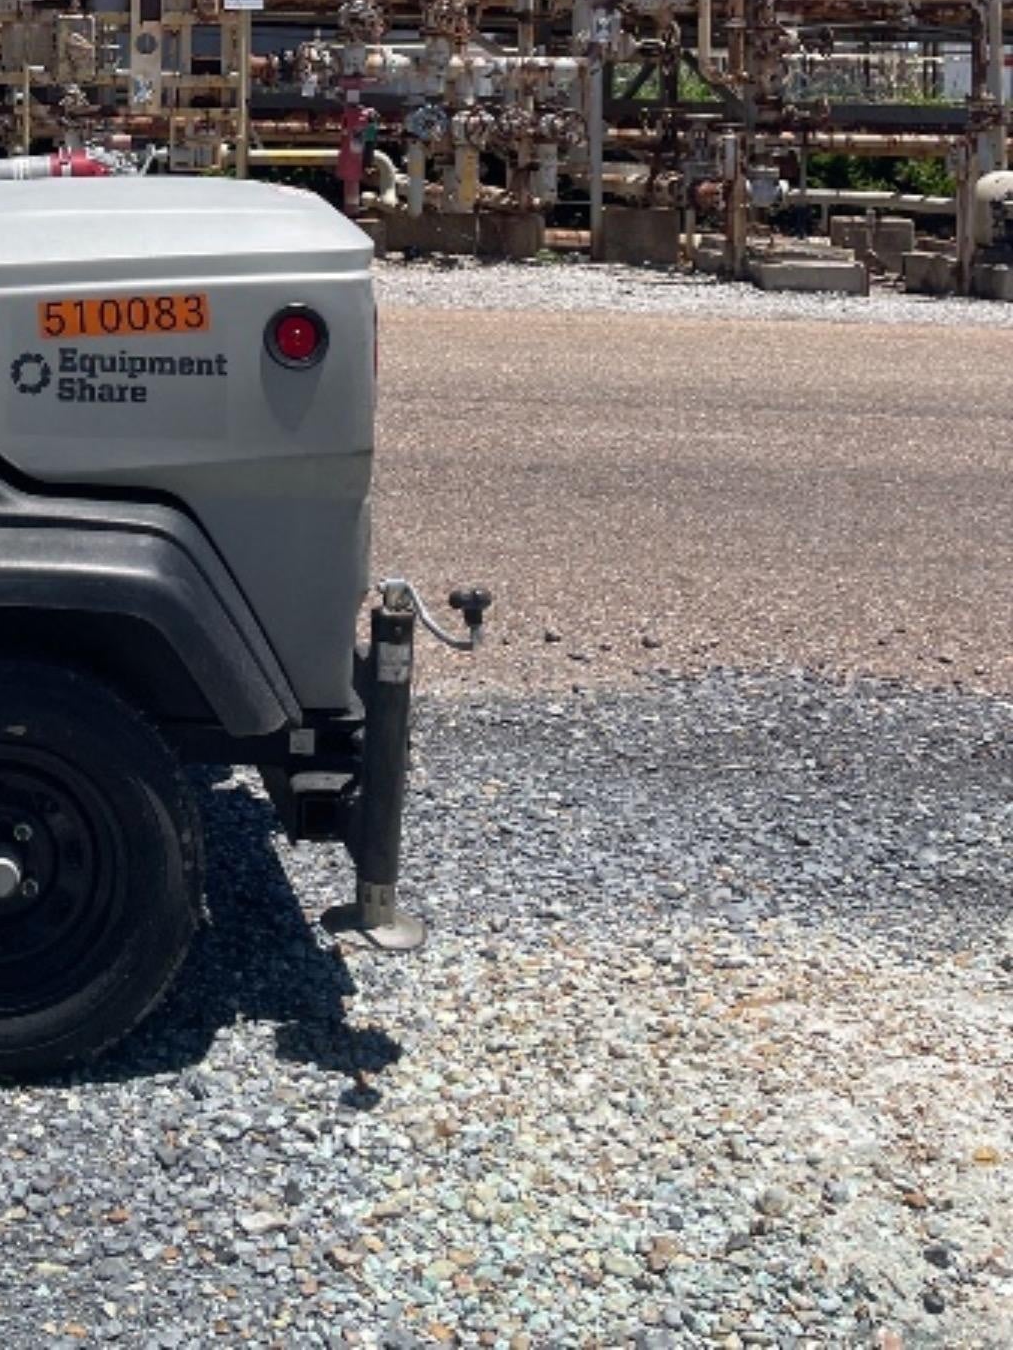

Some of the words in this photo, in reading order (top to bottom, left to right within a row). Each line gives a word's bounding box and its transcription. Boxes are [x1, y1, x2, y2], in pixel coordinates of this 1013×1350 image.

[43, 295, 205, 338] 510083
[57, 347, 228, 378] Equipment
[57, 377, 147, 403] Share
